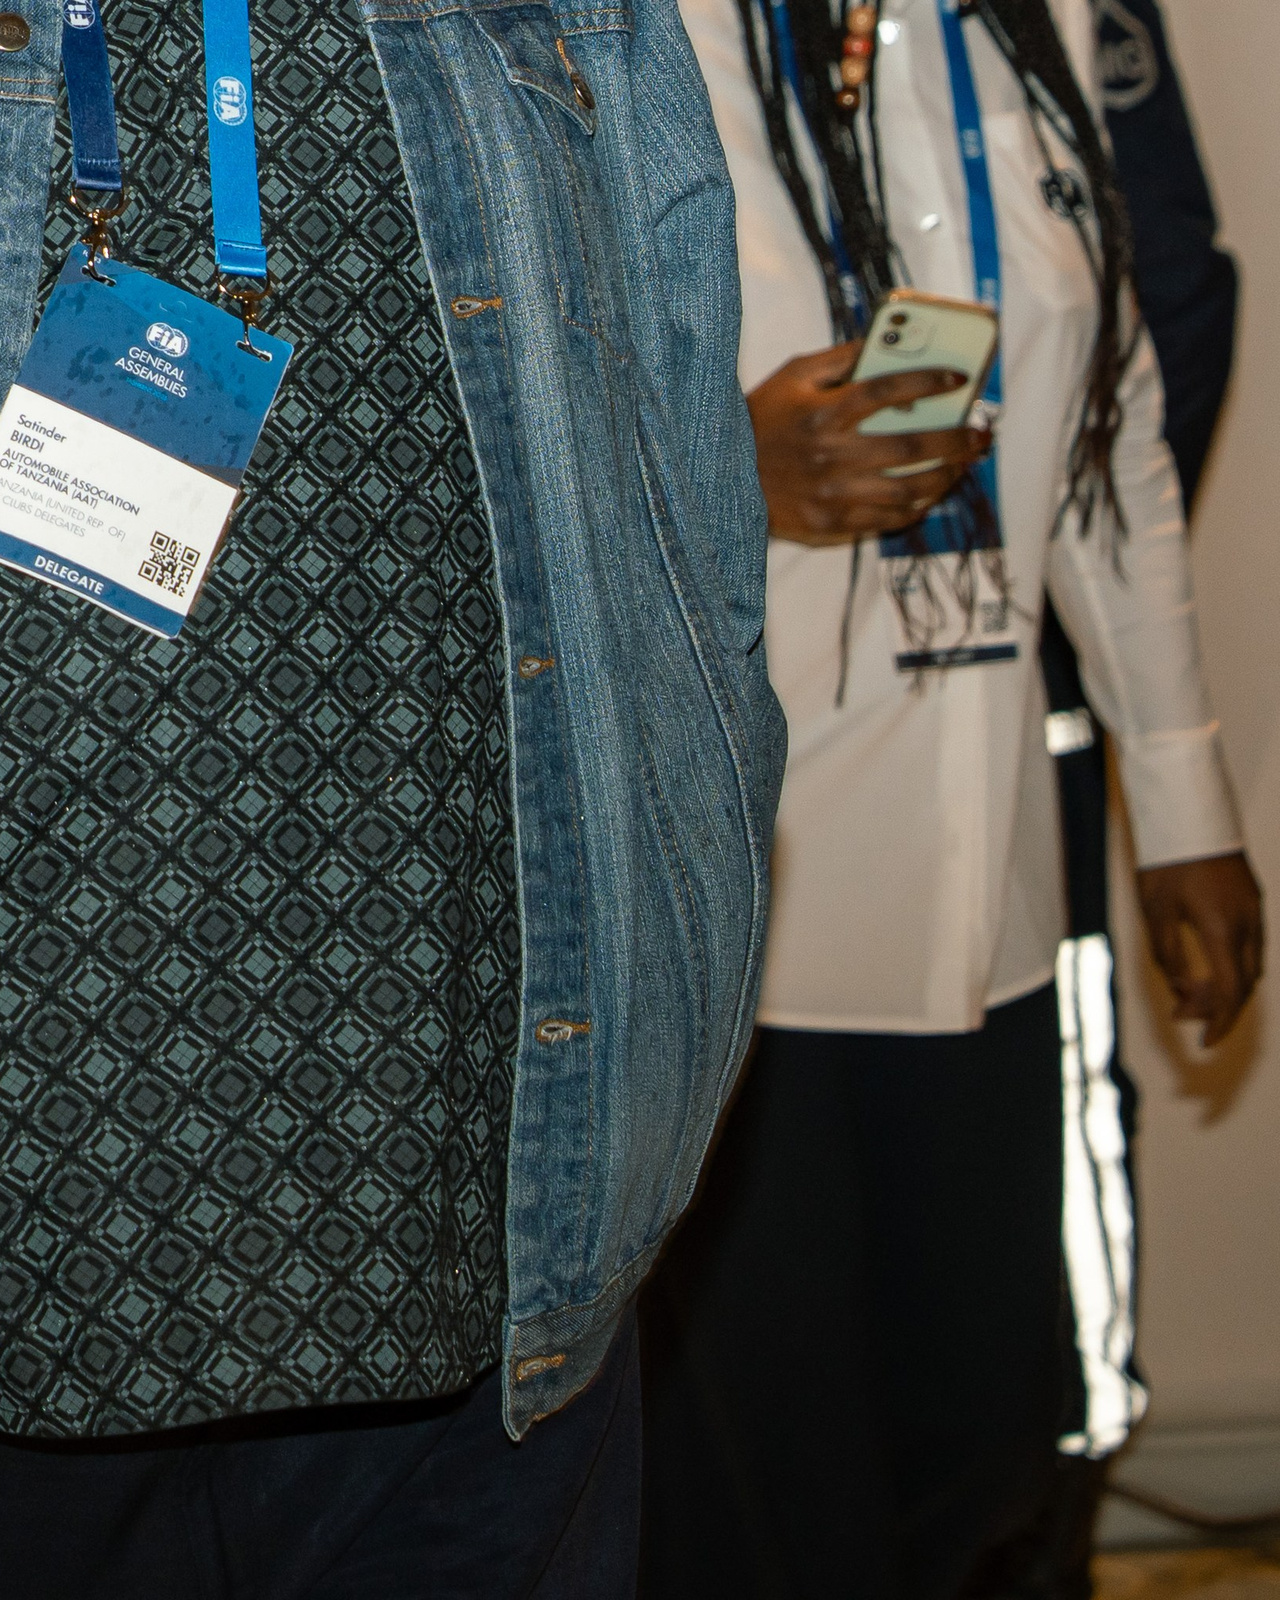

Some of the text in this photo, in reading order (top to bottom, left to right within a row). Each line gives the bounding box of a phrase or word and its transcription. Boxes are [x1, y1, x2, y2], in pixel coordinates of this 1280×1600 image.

[114, 357, 188, 398] ASSEMBLIES
[129, 346, 184, 382] GENERAL
[10, 429, 45, 453] BIRDI
[17, 413, 67, 443] Satinder
[0, 458, 98, 510] OF TANZANIA (AAT)
[3, 448, 140, 516] AUTOMOBILE ASSOCIATION
[2, 495, 32, 515] CLUBS
[34, 507, 86, 538] DELEGATES
[45, 497, 85, 520] (UNITED
[108, 526, 126, 542] OF)
[34, 554, 104, 595] DELEGATE
